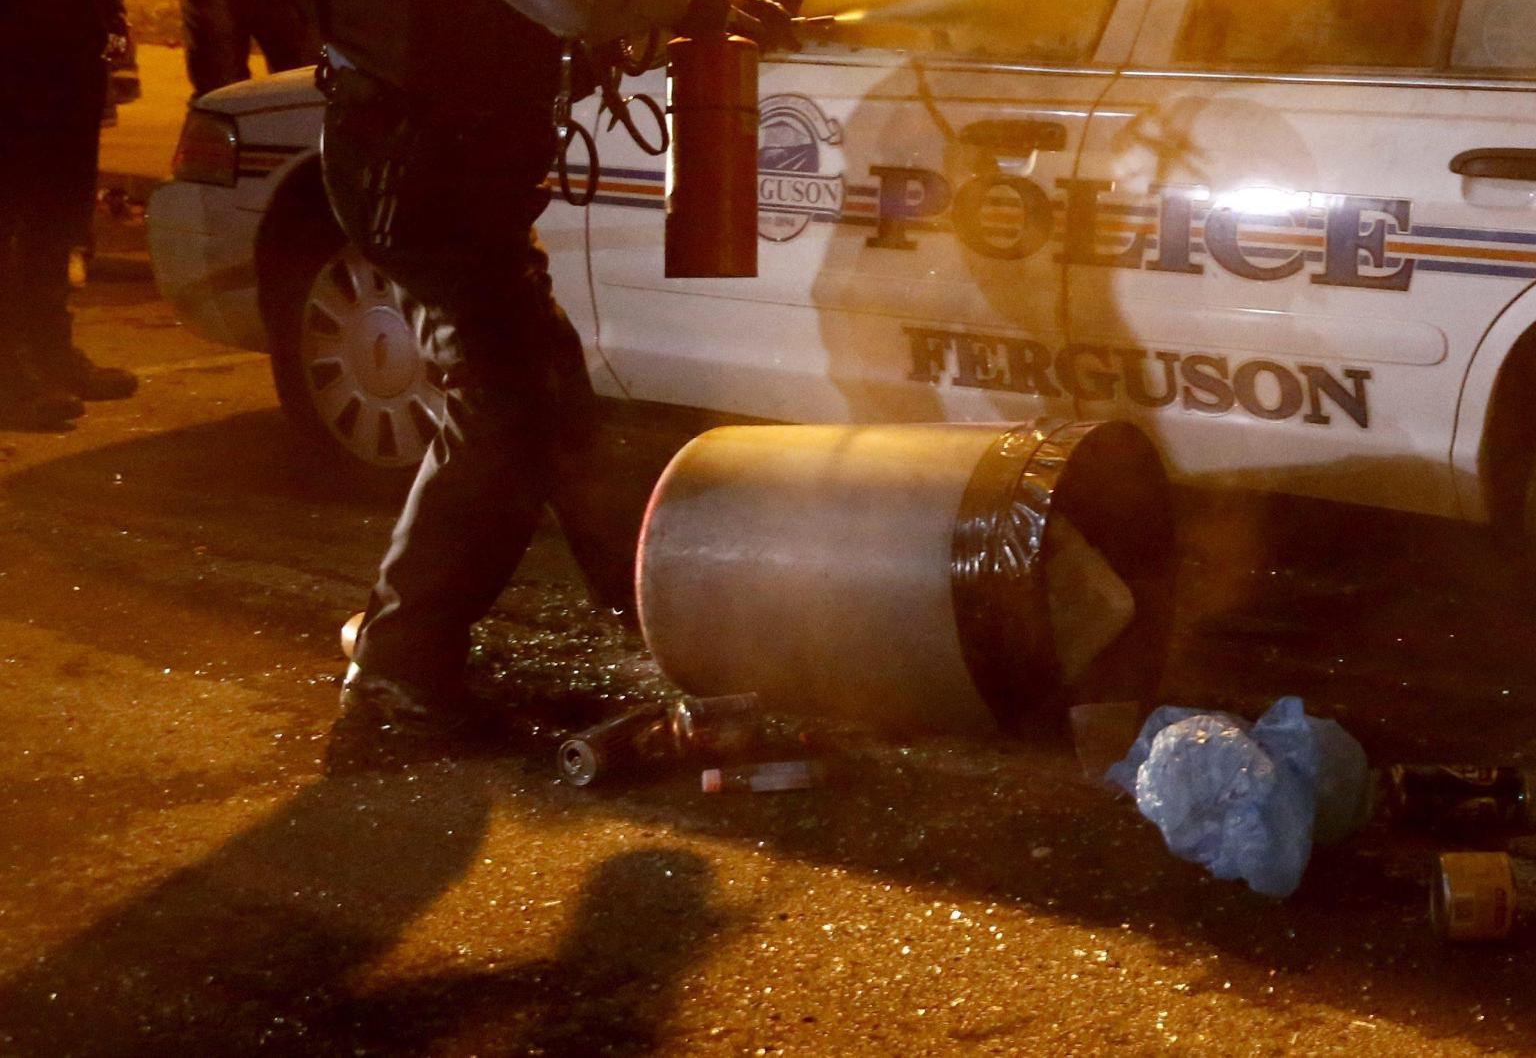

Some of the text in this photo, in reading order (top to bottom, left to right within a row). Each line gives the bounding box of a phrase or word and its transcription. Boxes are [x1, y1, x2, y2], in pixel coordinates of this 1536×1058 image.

[760, 178, 839, 203] GUSON
[865, 165, 1413, 292] POLICE
[903, 326, 1372, 429] FERGUSON
